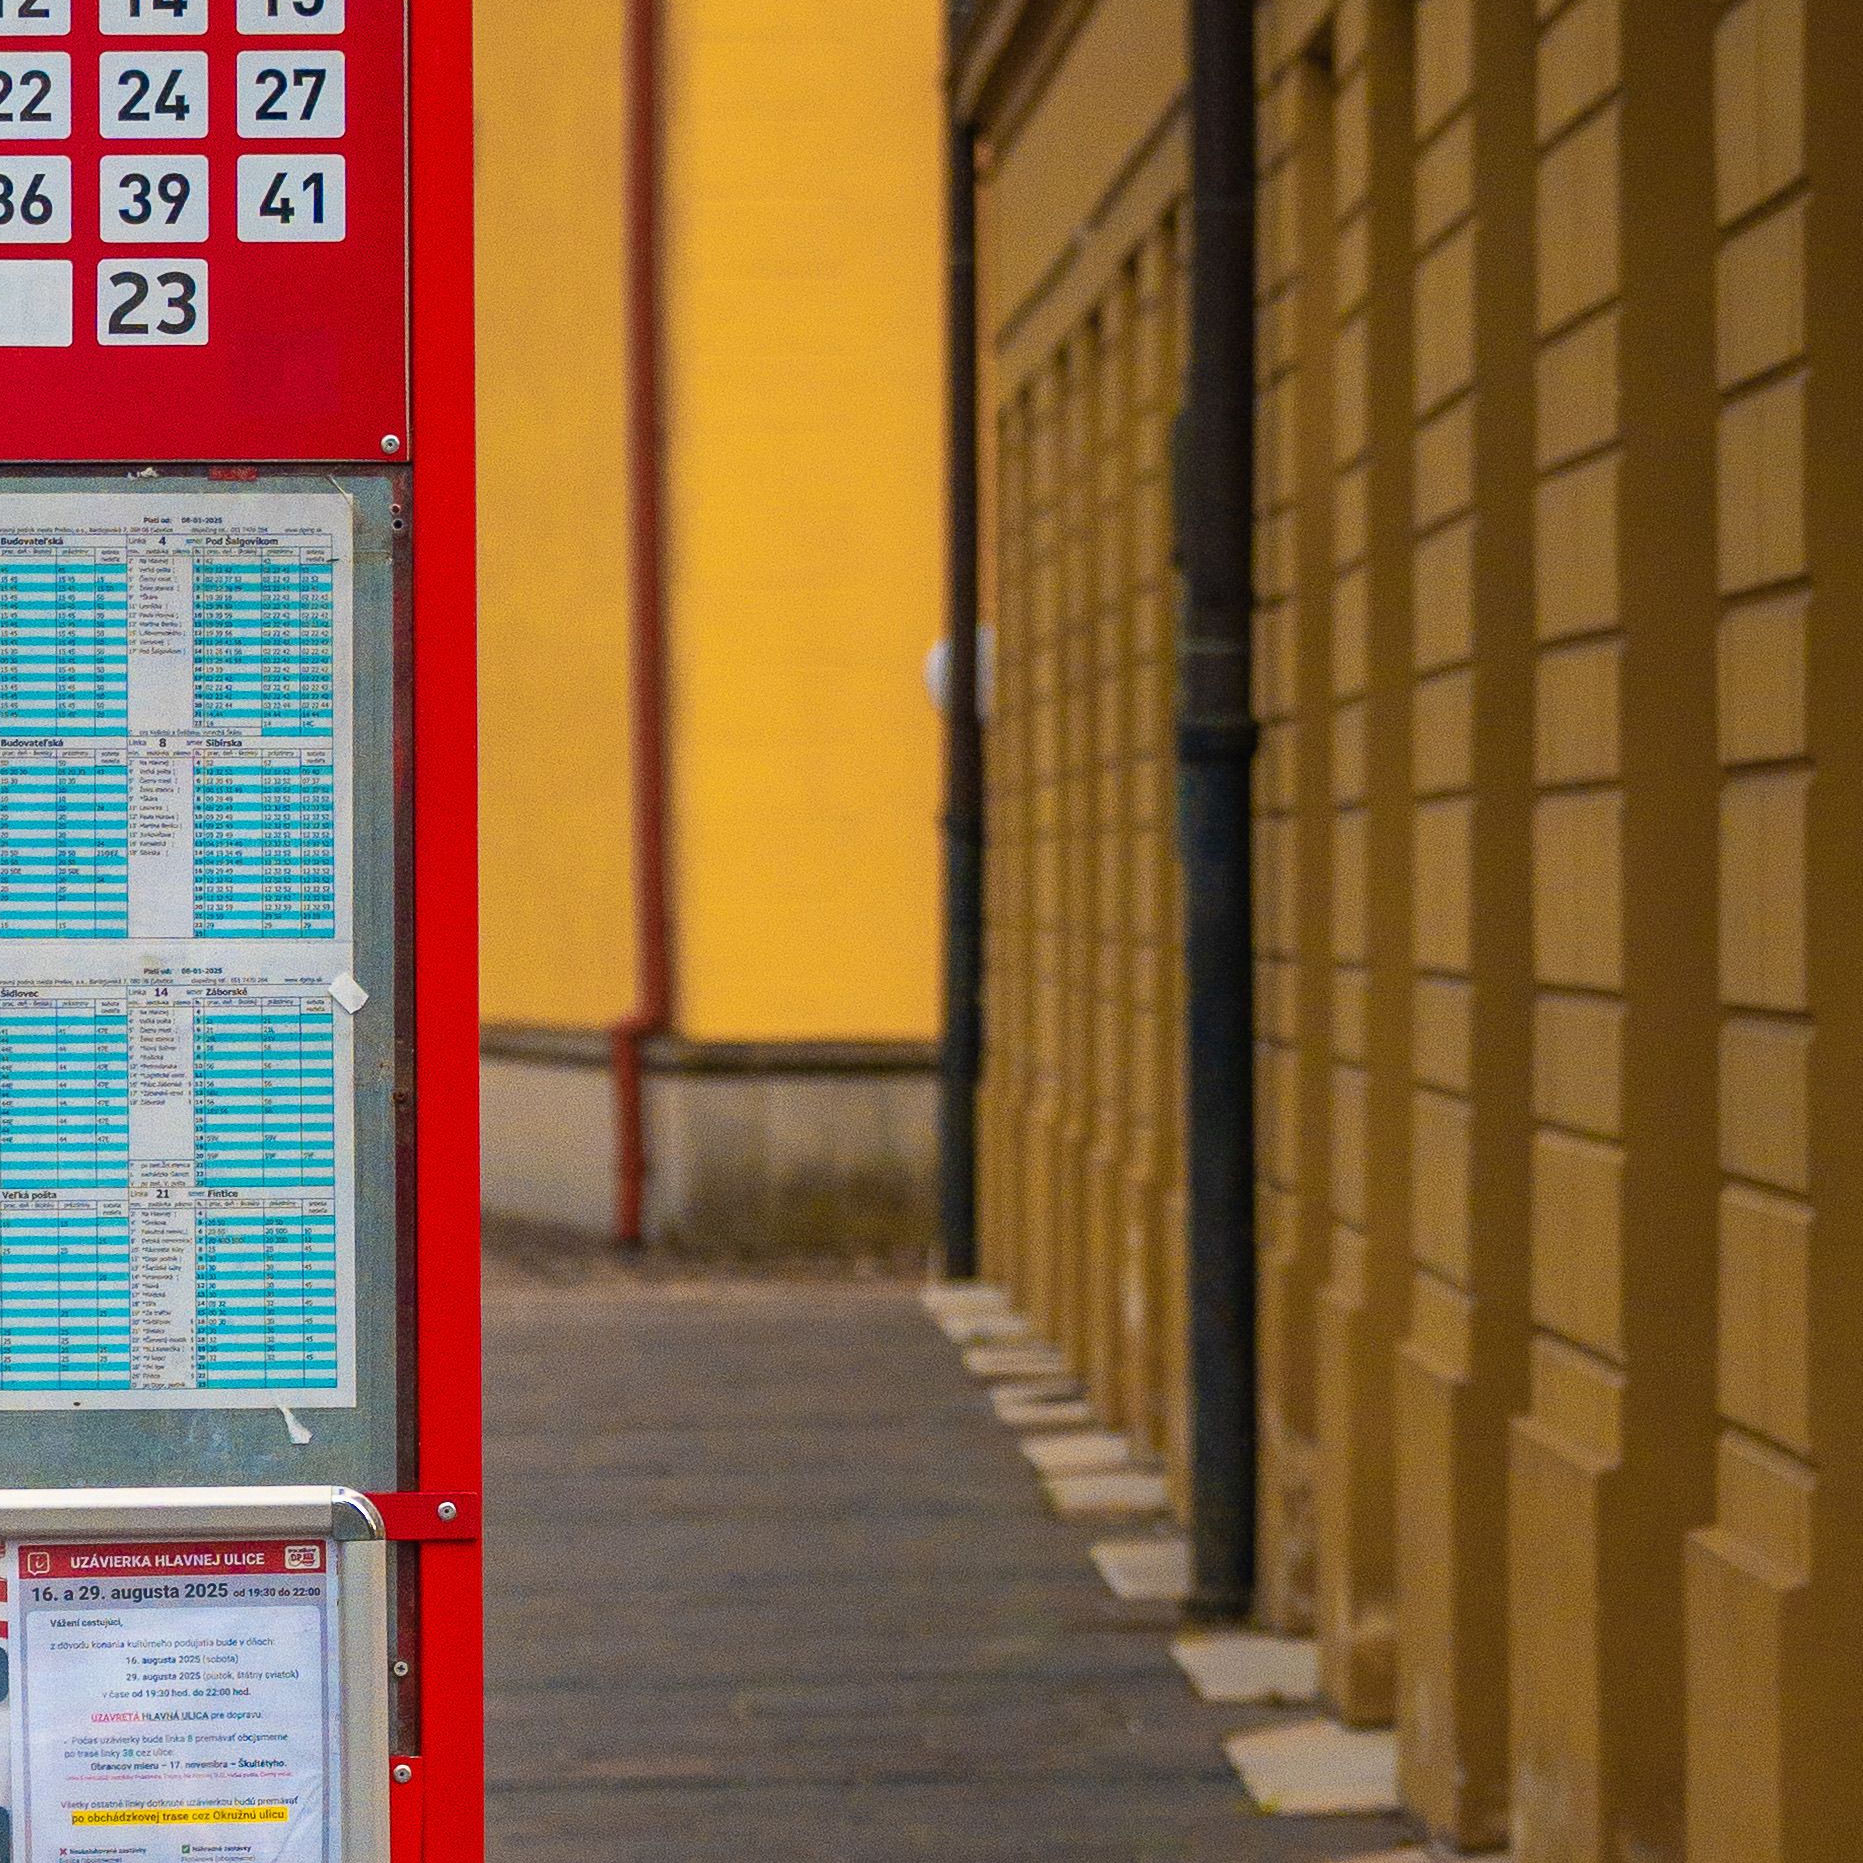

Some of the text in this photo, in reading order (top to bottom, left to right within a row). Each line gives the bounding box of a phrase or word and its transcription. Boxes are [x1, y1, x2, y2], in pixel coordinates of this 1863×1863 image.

[118, 70, 190, 121] 24
[255, 70, 326, 120] 27
[119, 174, 190, 225] 39
[259, 173, 325, 224] 41
[108, 273, 197, 334] 23
[0, 537, 64, 546] Budovateľská
[159, 537, 166, 546] 4
[206, 537, 224, 546] Pod
[0, 738, 64, 747] Budovateľská
[159, 738, 242, 747] 8 Sibírska
[155, 987, 247, 996] 14 Záborské
[2, 1190, 28, 1199] Veľká
[32, 1191, 56, 1200] pošta
[156, 1189, 238, 1198] 21 Fintice
[71, 1553, 264, 1568] UZÁVIERKA HLAVNEJ ULICE
[32, 1583, 320, 1603] 16. a 29. augusta 2025 od 19:30 do 22:00
[50, 1618, 79, 1627] Vážení
[92, 1640, 124, 1648] konania
[174, 1639, 214, 1649] podujatia
[216, 1638, 237, 1647] bude
[127, 1657, 139, 1665] 16.
[142, 1656, 176, 1666] augusta
[179, 1655, 200, 1663] 2025
[126, 1673, 139, 1681] 29.
[142, 1673, 176, 1683] augusta
[179, 1672, 200, 1680] 2025
[132, 1689, 143, 1697] od
[145, 1689, 169, 1697] 19:30
[193, 1688, 204, 1696] do
[206, 1688, 230, 1696] 22:00
[181, 1712, 208, 1720] ULICA
[211, 1712, 224, 1721] pre
[72, 1813, 84, 1823] po
[88, 1810, 160, 1824] obchádzkovej
[162, 1812, 188, 1820] trase
[192, 1812, 210, 1820] cez
[213, 1809, 256, 1820] Okružnú
